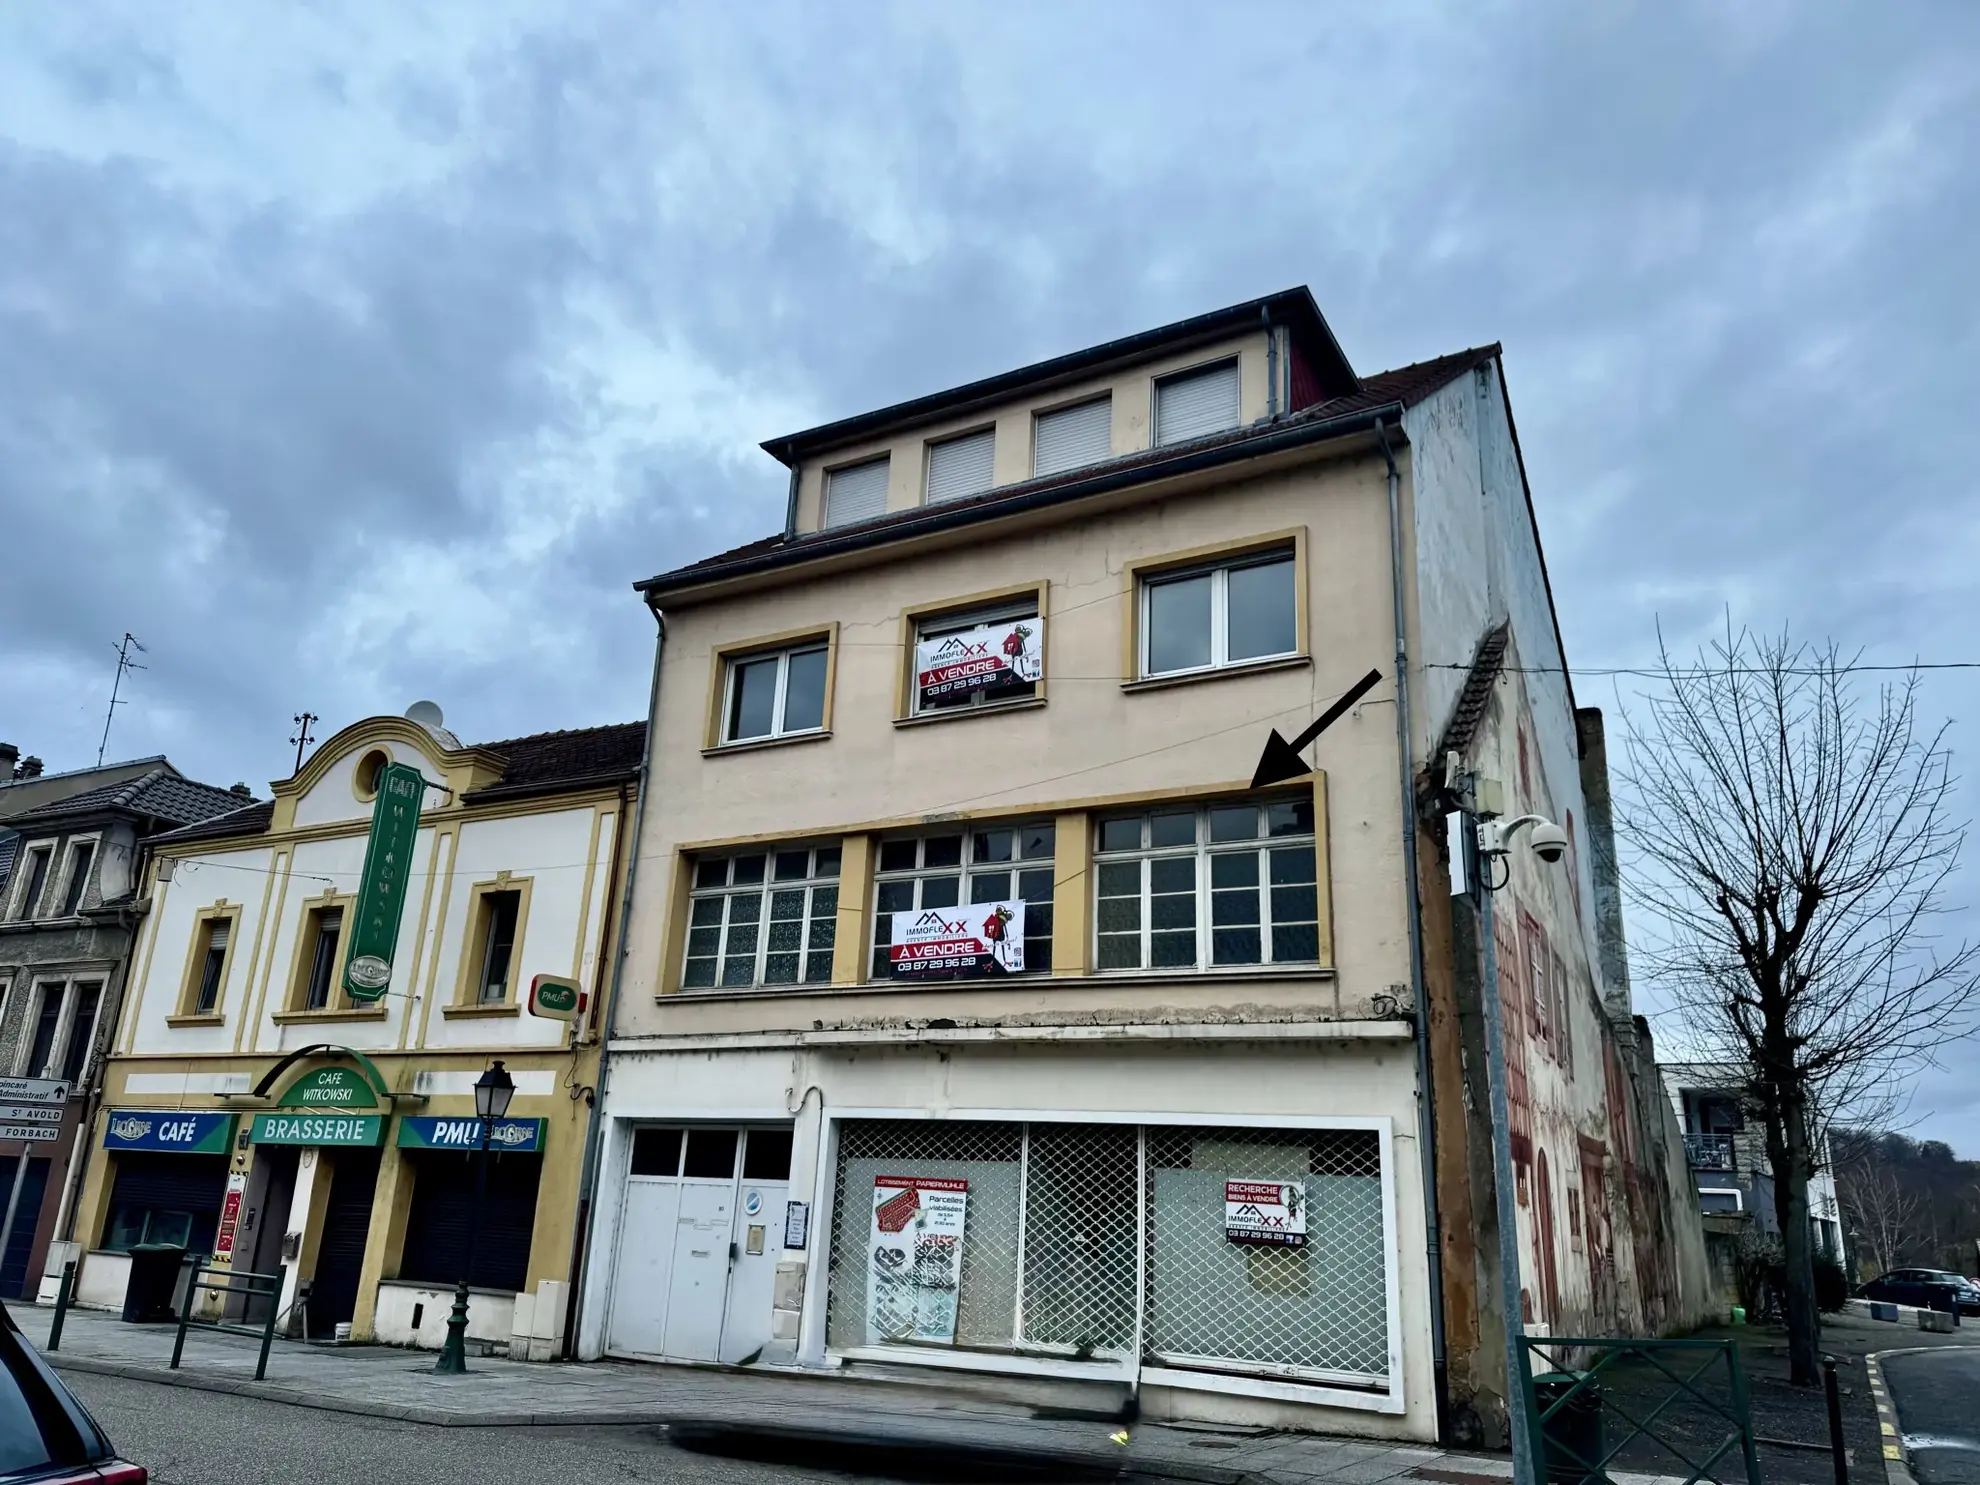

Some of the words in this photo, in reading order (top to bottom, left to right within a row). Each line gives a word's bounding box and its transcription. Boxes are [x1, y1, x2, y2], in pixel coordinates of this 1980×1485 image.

[927, 671, 937, 684] À
[938, 660, 995, 681] VENDRE
[927, 686, 940, 696] 03
[940, 683, 953, 693] 87
[953, 680, 967, 689] 29
[967, 676, 981, 686] 96
[982, 673, 997, 683] 28
[899, 944, 910, 959] À
[913, 941, 975, 957] VENDRE
[897, 962, 912, 972] 03
[913, 961, 928, 970] 87
[928, 959, 943, 969] 29
[944, 958, 960, 967] 96
[961, 957, 976, 966] 28
[541, 991, 560, 1003] PMU
[318, 1072, 343, 1085] CAFE
[302, 1088, 353, 1101] WITKOWSKI
[26, 1110, 60, 1120] AVOLD
[5, 1128, 56, 1138] FORBACH
[158, 1116, 197, 1142] CAFÉ
[264, 1118, 366, 1140] BRASSERIE
[432, 1121, 480, 1145] PMU
[1228, 1183, 1278, 1195] RECHERCHE
[929, 1195, 964, 1204] Parcelles
[1227, 1193, 1246, 1201] BIENS
[1253, 1195, 1278, 1203] VENDRE
[1228, 1229, 1239, 1237] 03
[1239, 1230, 1250, 1238] 87
